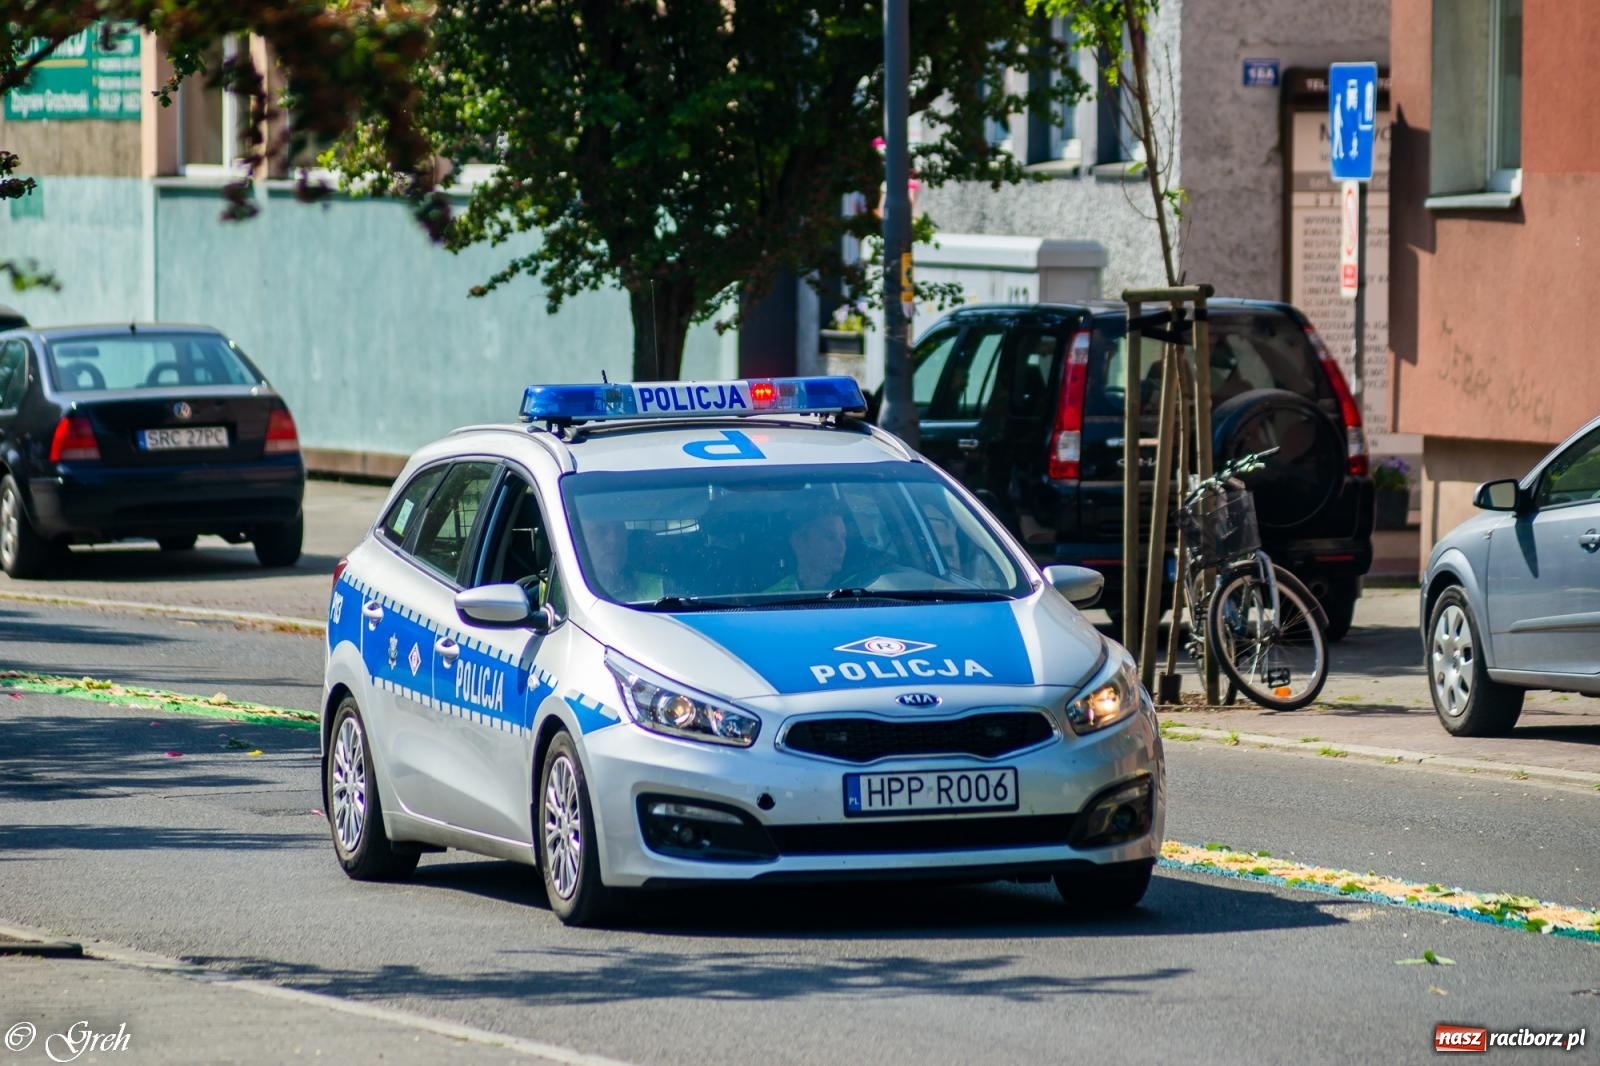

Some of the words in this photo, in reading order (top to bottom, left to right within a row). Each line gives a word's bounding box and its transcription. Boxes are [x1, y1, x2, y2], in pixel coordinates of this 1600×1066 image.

[640, 384, 747, 412] POLICJA
[148, 430, 181, 447] SRC
[809, 658, 994, 685] POLICJA
[455, 659, 504, 713] POLICJA
[902, 693, 935, 705] KIA
[866, 775, 925, 807] HPP
[936, 772, 1009, 805] R006
